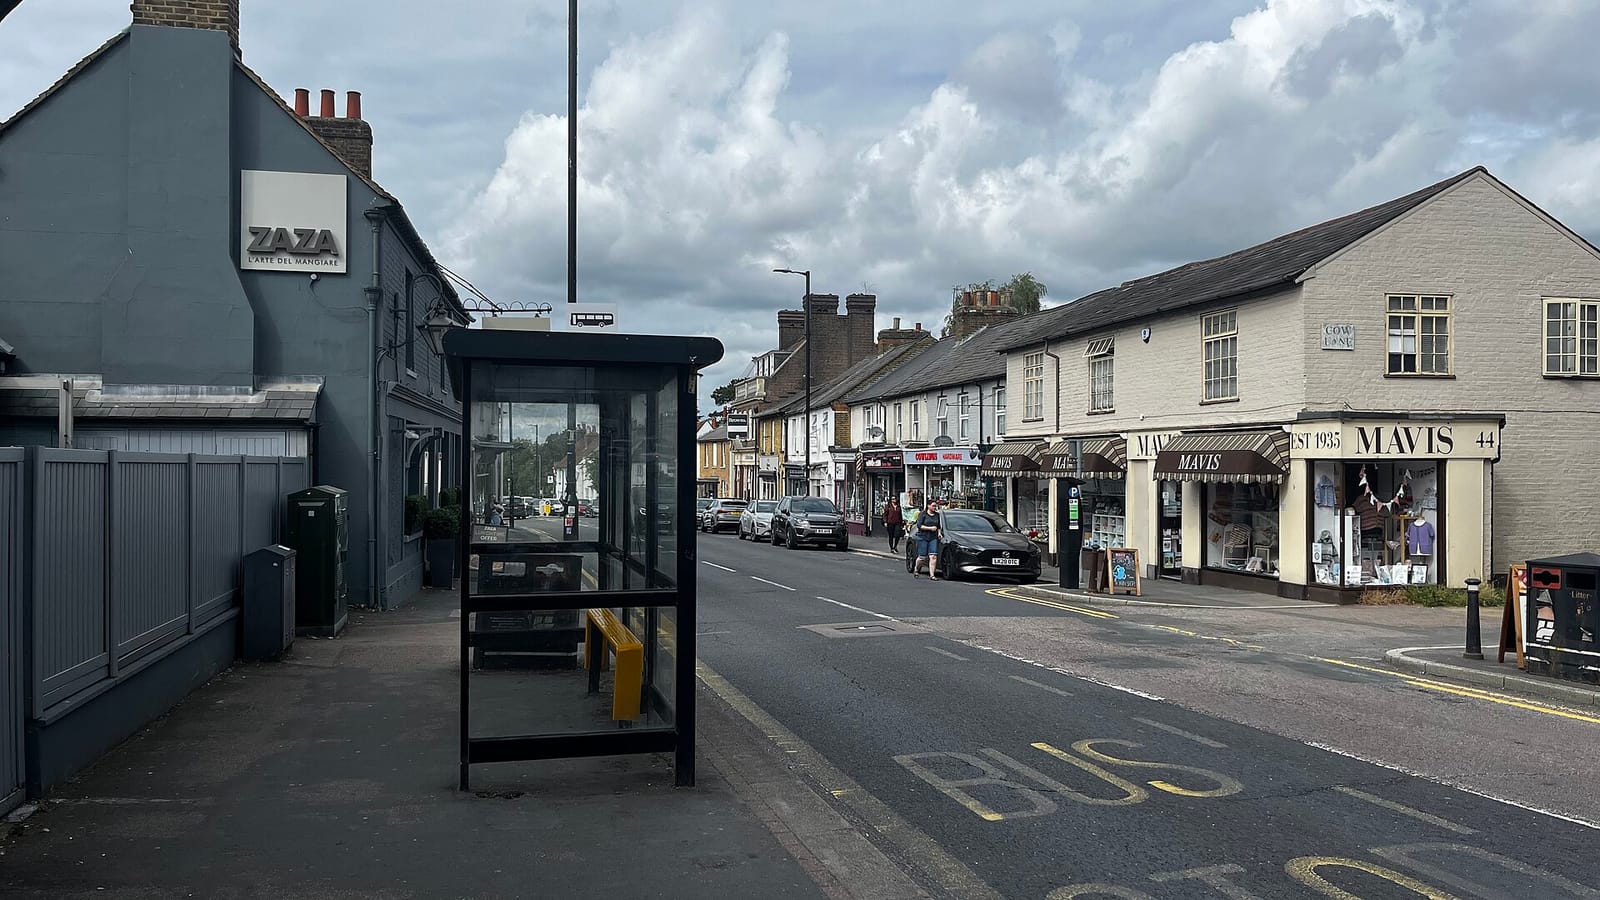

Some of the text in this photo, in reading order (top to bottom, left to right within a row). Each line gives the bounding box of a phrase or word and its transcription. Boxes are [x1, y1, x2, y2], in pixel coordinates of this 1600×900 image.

[246, 226, 338, 256] ZAZA
[248, 256, 338, 267] L'ARTE DEL MANGIARE
[1325, 325, 1352, 336] COW
[1290, 431, 1341, 450] EST 1935
[1354, 426, 1454, 455] MAVIS
[1475, 431, 1495, 449] 44
[989, 456, 1014, 470] MAVIS
[1177, 453, 1222, 471] MAVIS
[1071, 486, 1078, 498] P
[1571, 590, 1590, 599] Litter
[893, 738, 1242, 822] BUS
